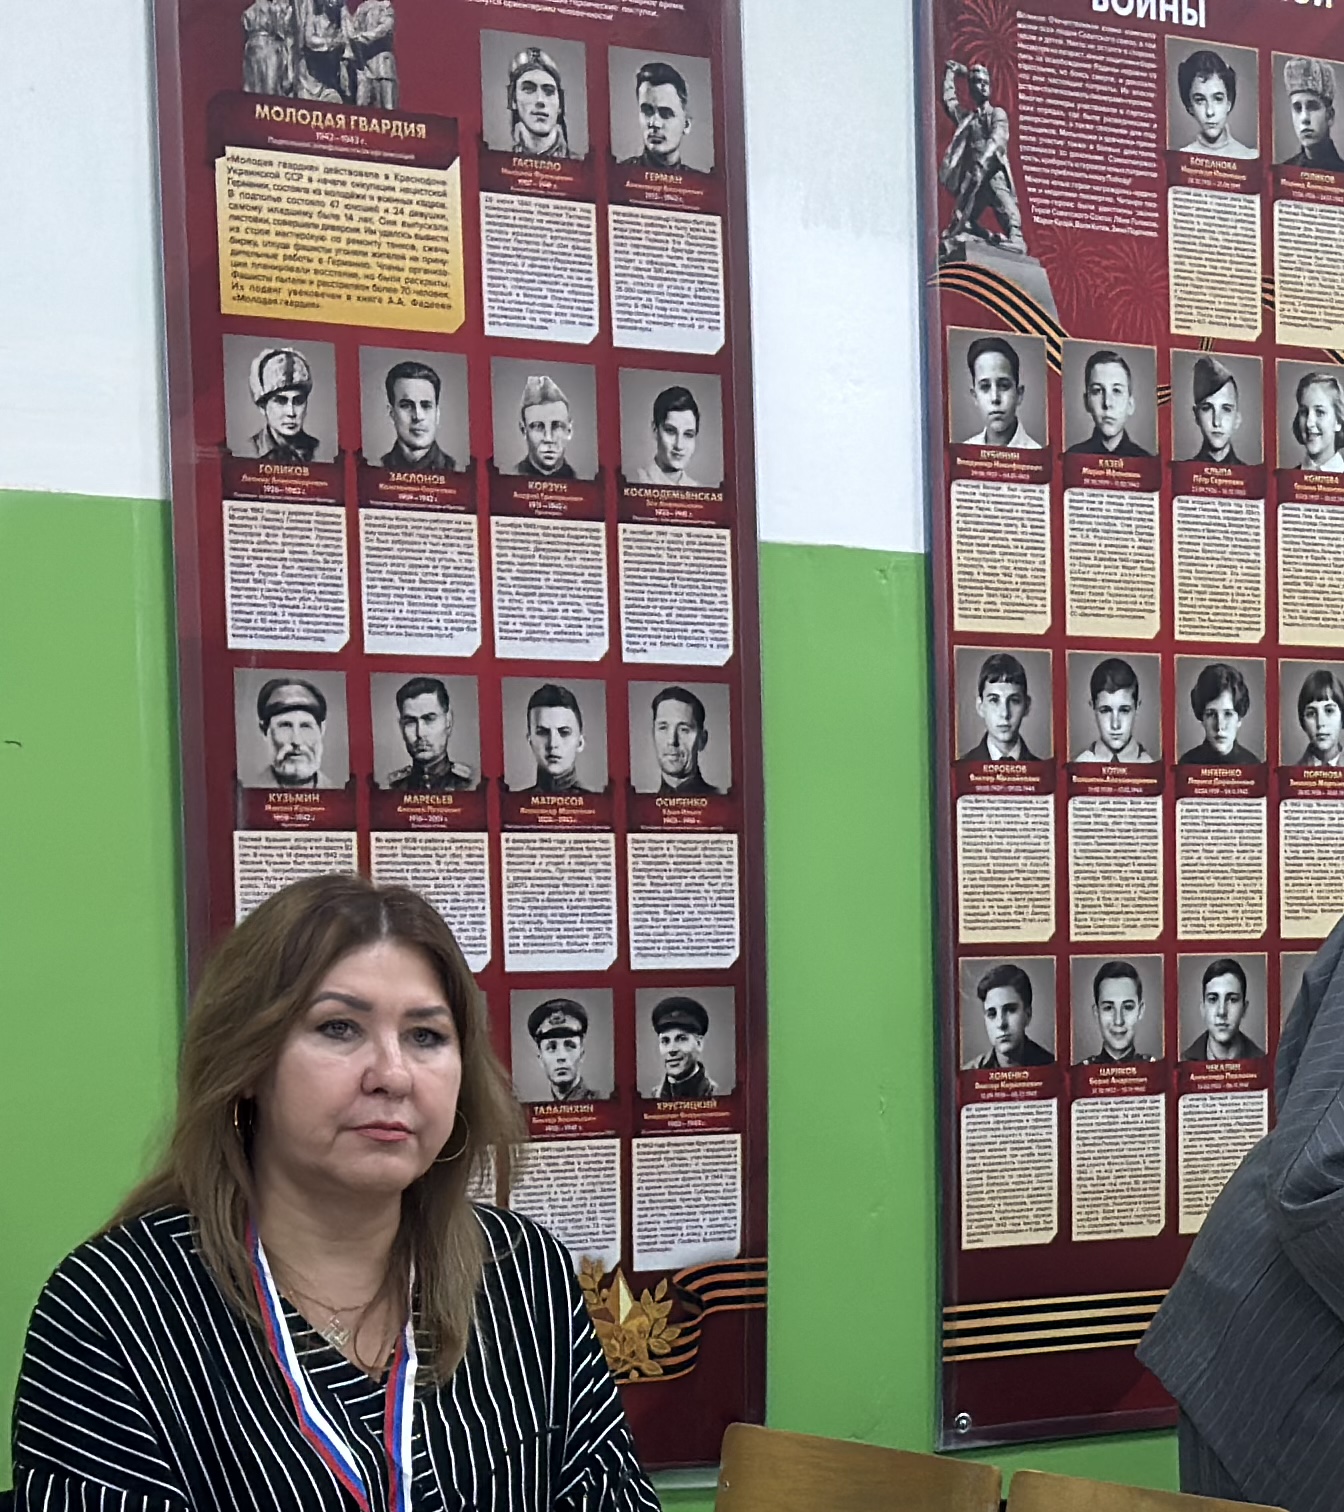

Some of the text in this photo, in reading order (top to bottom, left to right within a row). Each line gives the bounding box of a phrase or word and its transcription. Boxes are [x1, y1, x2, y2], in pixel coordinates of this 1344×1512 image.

[255, 104, 427, 139] МОЛОДАЯ ГВАРДИЯ
[259, 463, 310, 477] ГОЛИКОВ
[389, 471, 446, 485] ЗАСЛОНОВ
[528, 481, 568, 493] КОРЗУН
[624, 487, 724, 502] КОСМОДЕМЬЯНСКАЯ
[268, 792, 320, 804] КУЗЬМИН
[403, 794, 453, 804] МАРЕСЬЕВ
[531, 796, 584, 806] МАТРОСОВ
